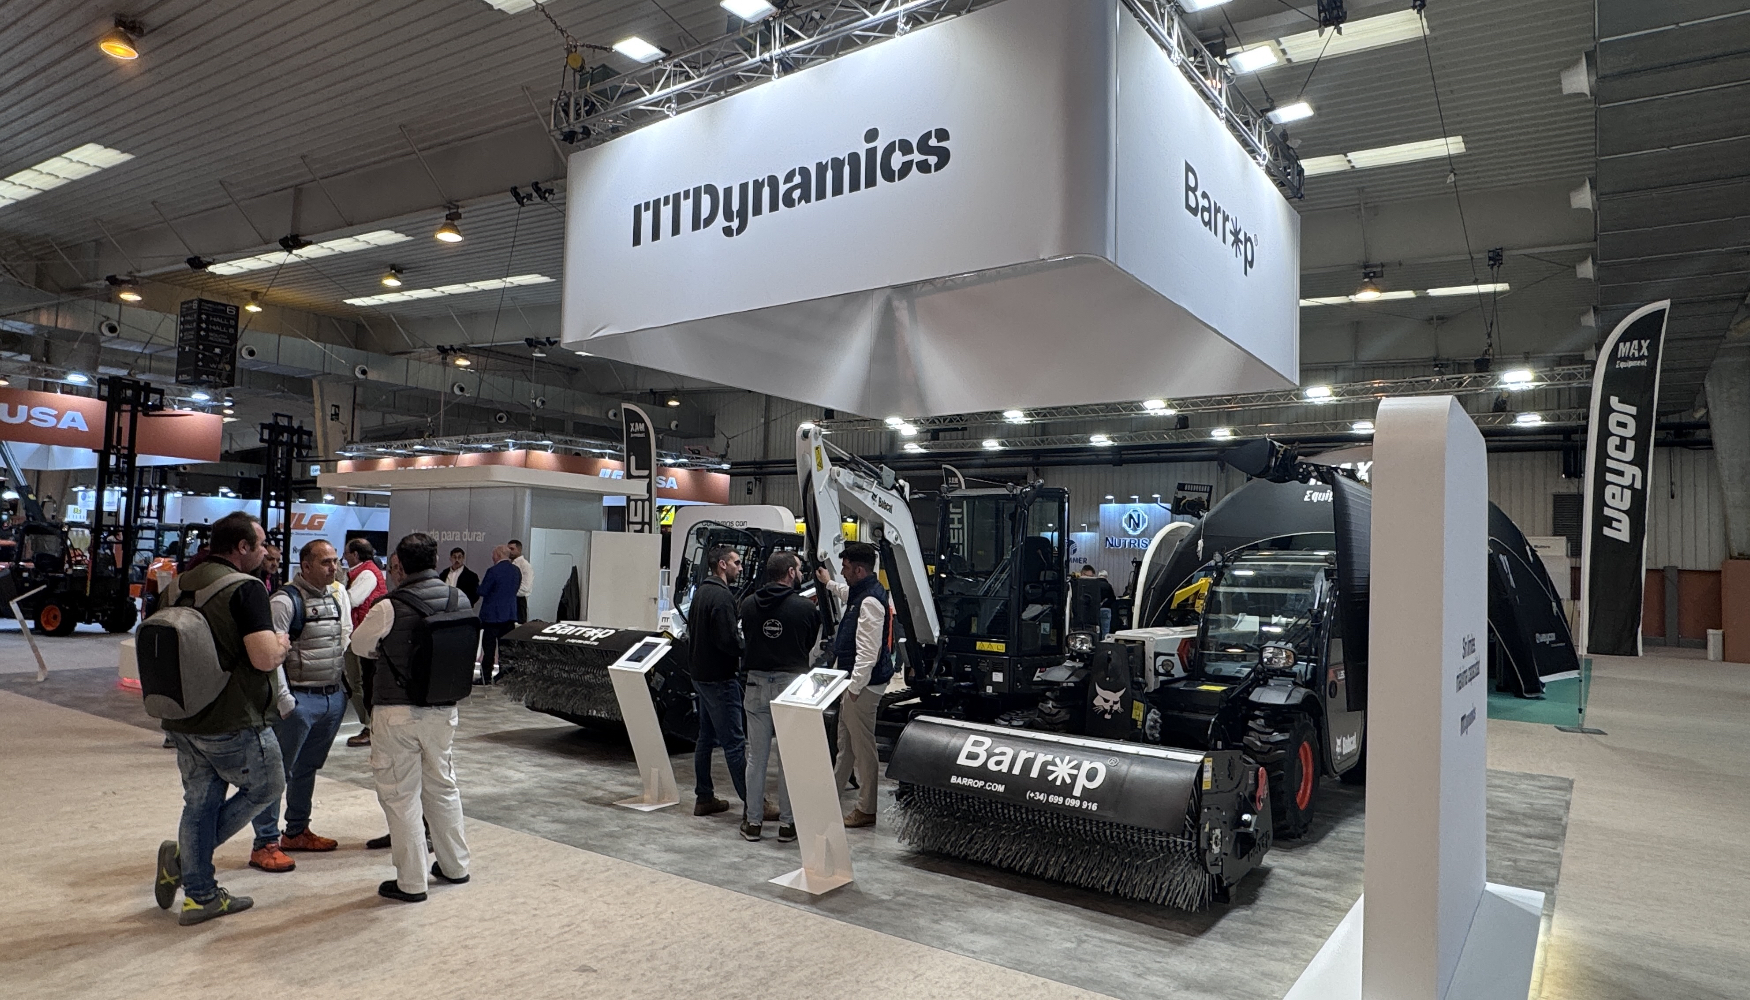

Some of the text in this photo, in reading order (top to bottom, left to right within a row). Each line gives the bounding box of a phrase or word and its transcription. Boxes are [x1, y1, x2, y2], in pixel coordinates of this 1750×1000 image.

[1618, 339, 1650, 358] MAX
[1603, 396, 1642, 543] weycor
[878, 496, 893, 515] Bobcat
[462, 529, 486, 542] durar
[950, 775, 1006, 793] BARROP.COM
[1026, 790, 1098, 811] (+34) 699 099 916
